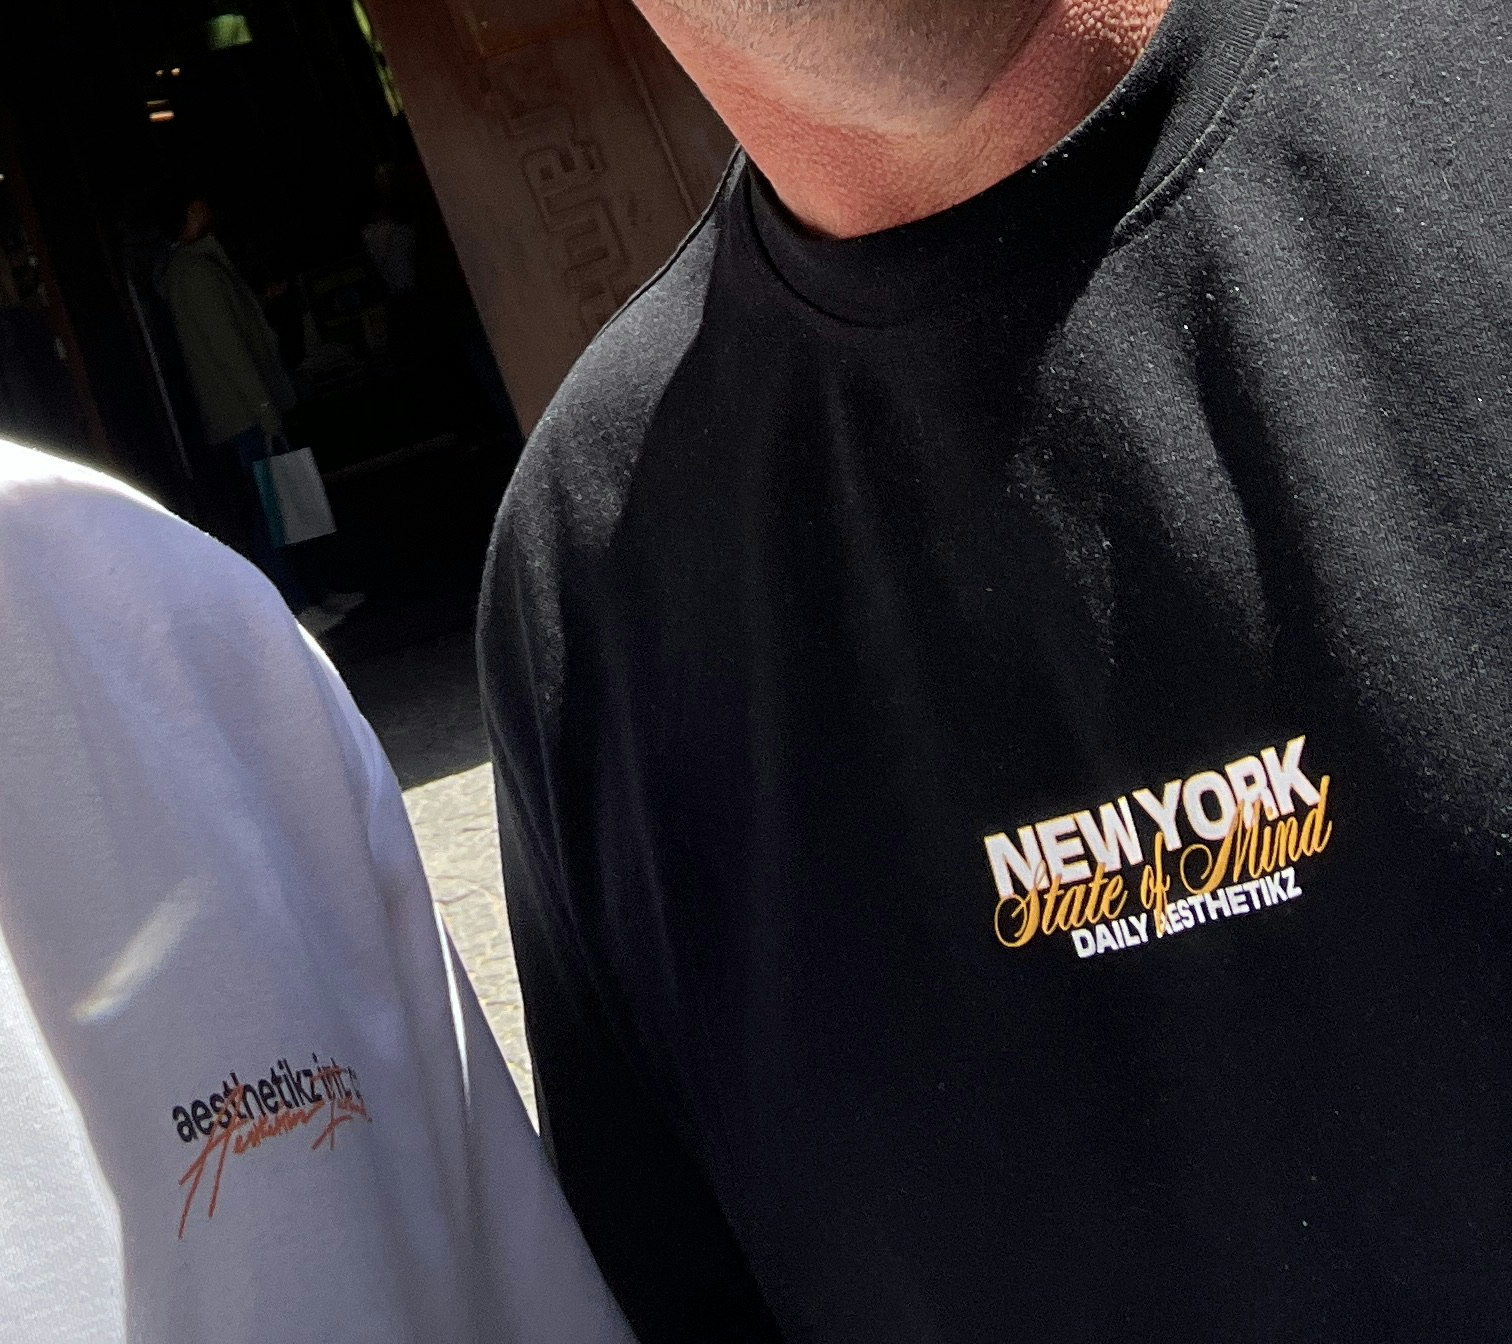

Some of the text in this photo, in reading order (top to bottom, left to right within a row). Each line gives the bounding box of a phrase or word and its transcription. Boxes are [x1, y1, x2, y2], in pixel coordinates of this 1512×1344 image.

[985, 735, 1322, 898] NEW YORK
[994, 775, 1333, 948] State of Mind
[1071, 912, 1150, 960] DAILY
